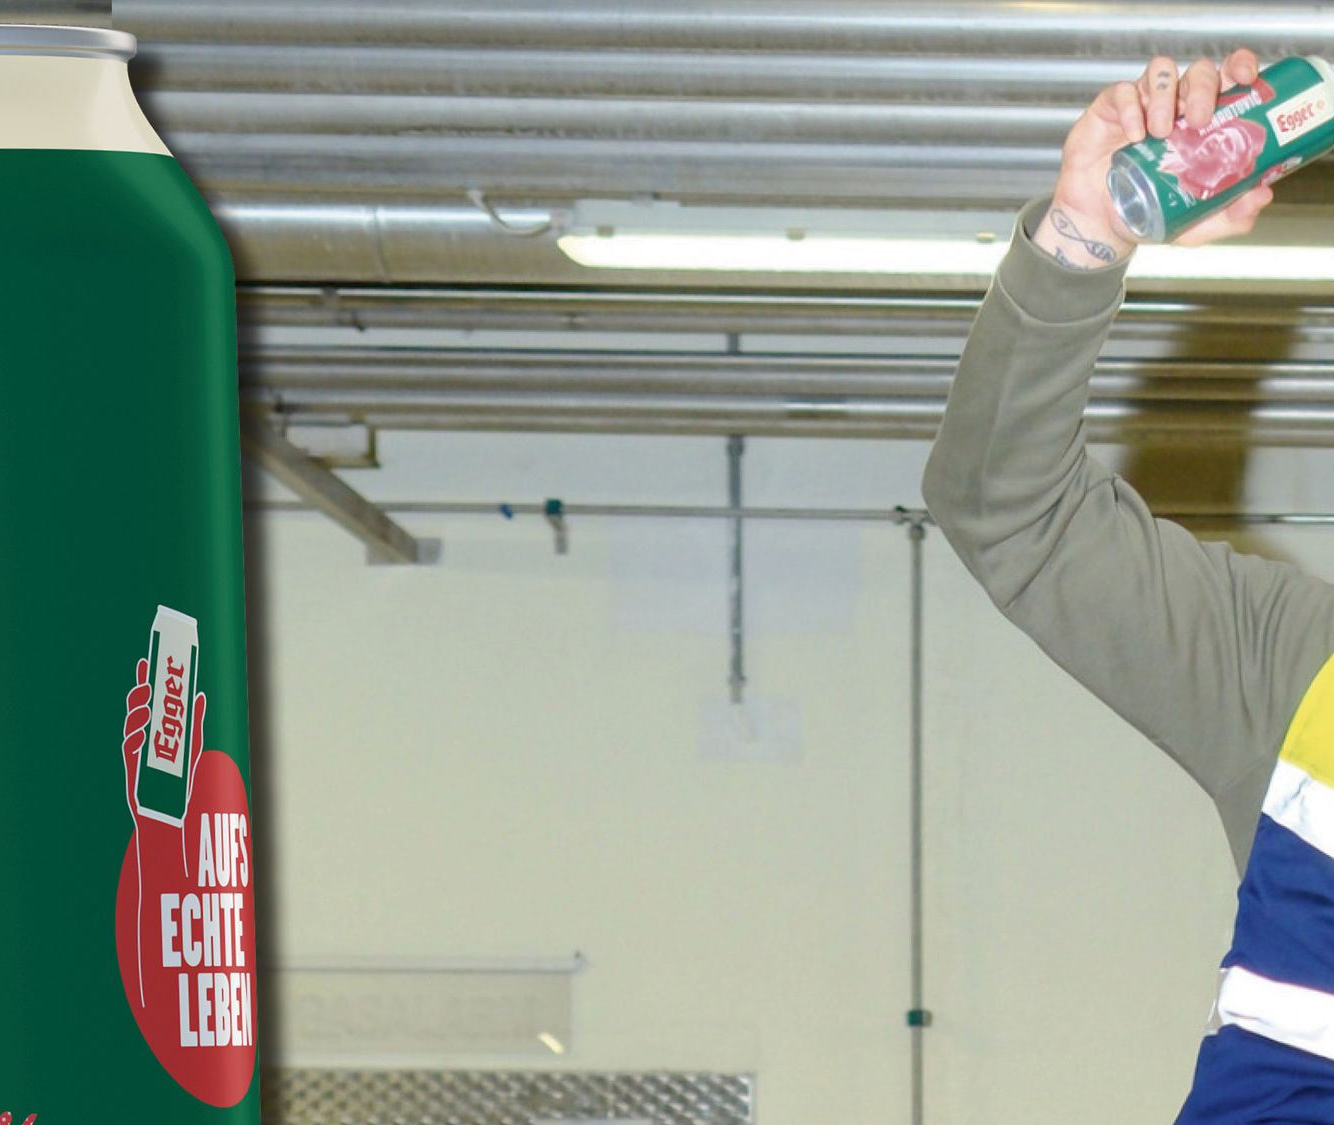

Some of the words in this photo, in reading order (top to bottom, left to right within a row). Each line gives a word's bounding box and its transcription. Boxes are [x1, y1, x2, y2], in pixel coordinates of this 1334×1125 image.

[1275, 101, 1316, 133] Egger
[153, 655, 185, 764] Egger
[197, 812, 249, 888] AUFS
[160, 892, 246, 967] ECHTE
[178, 972, 253, 1047] LEBEN
